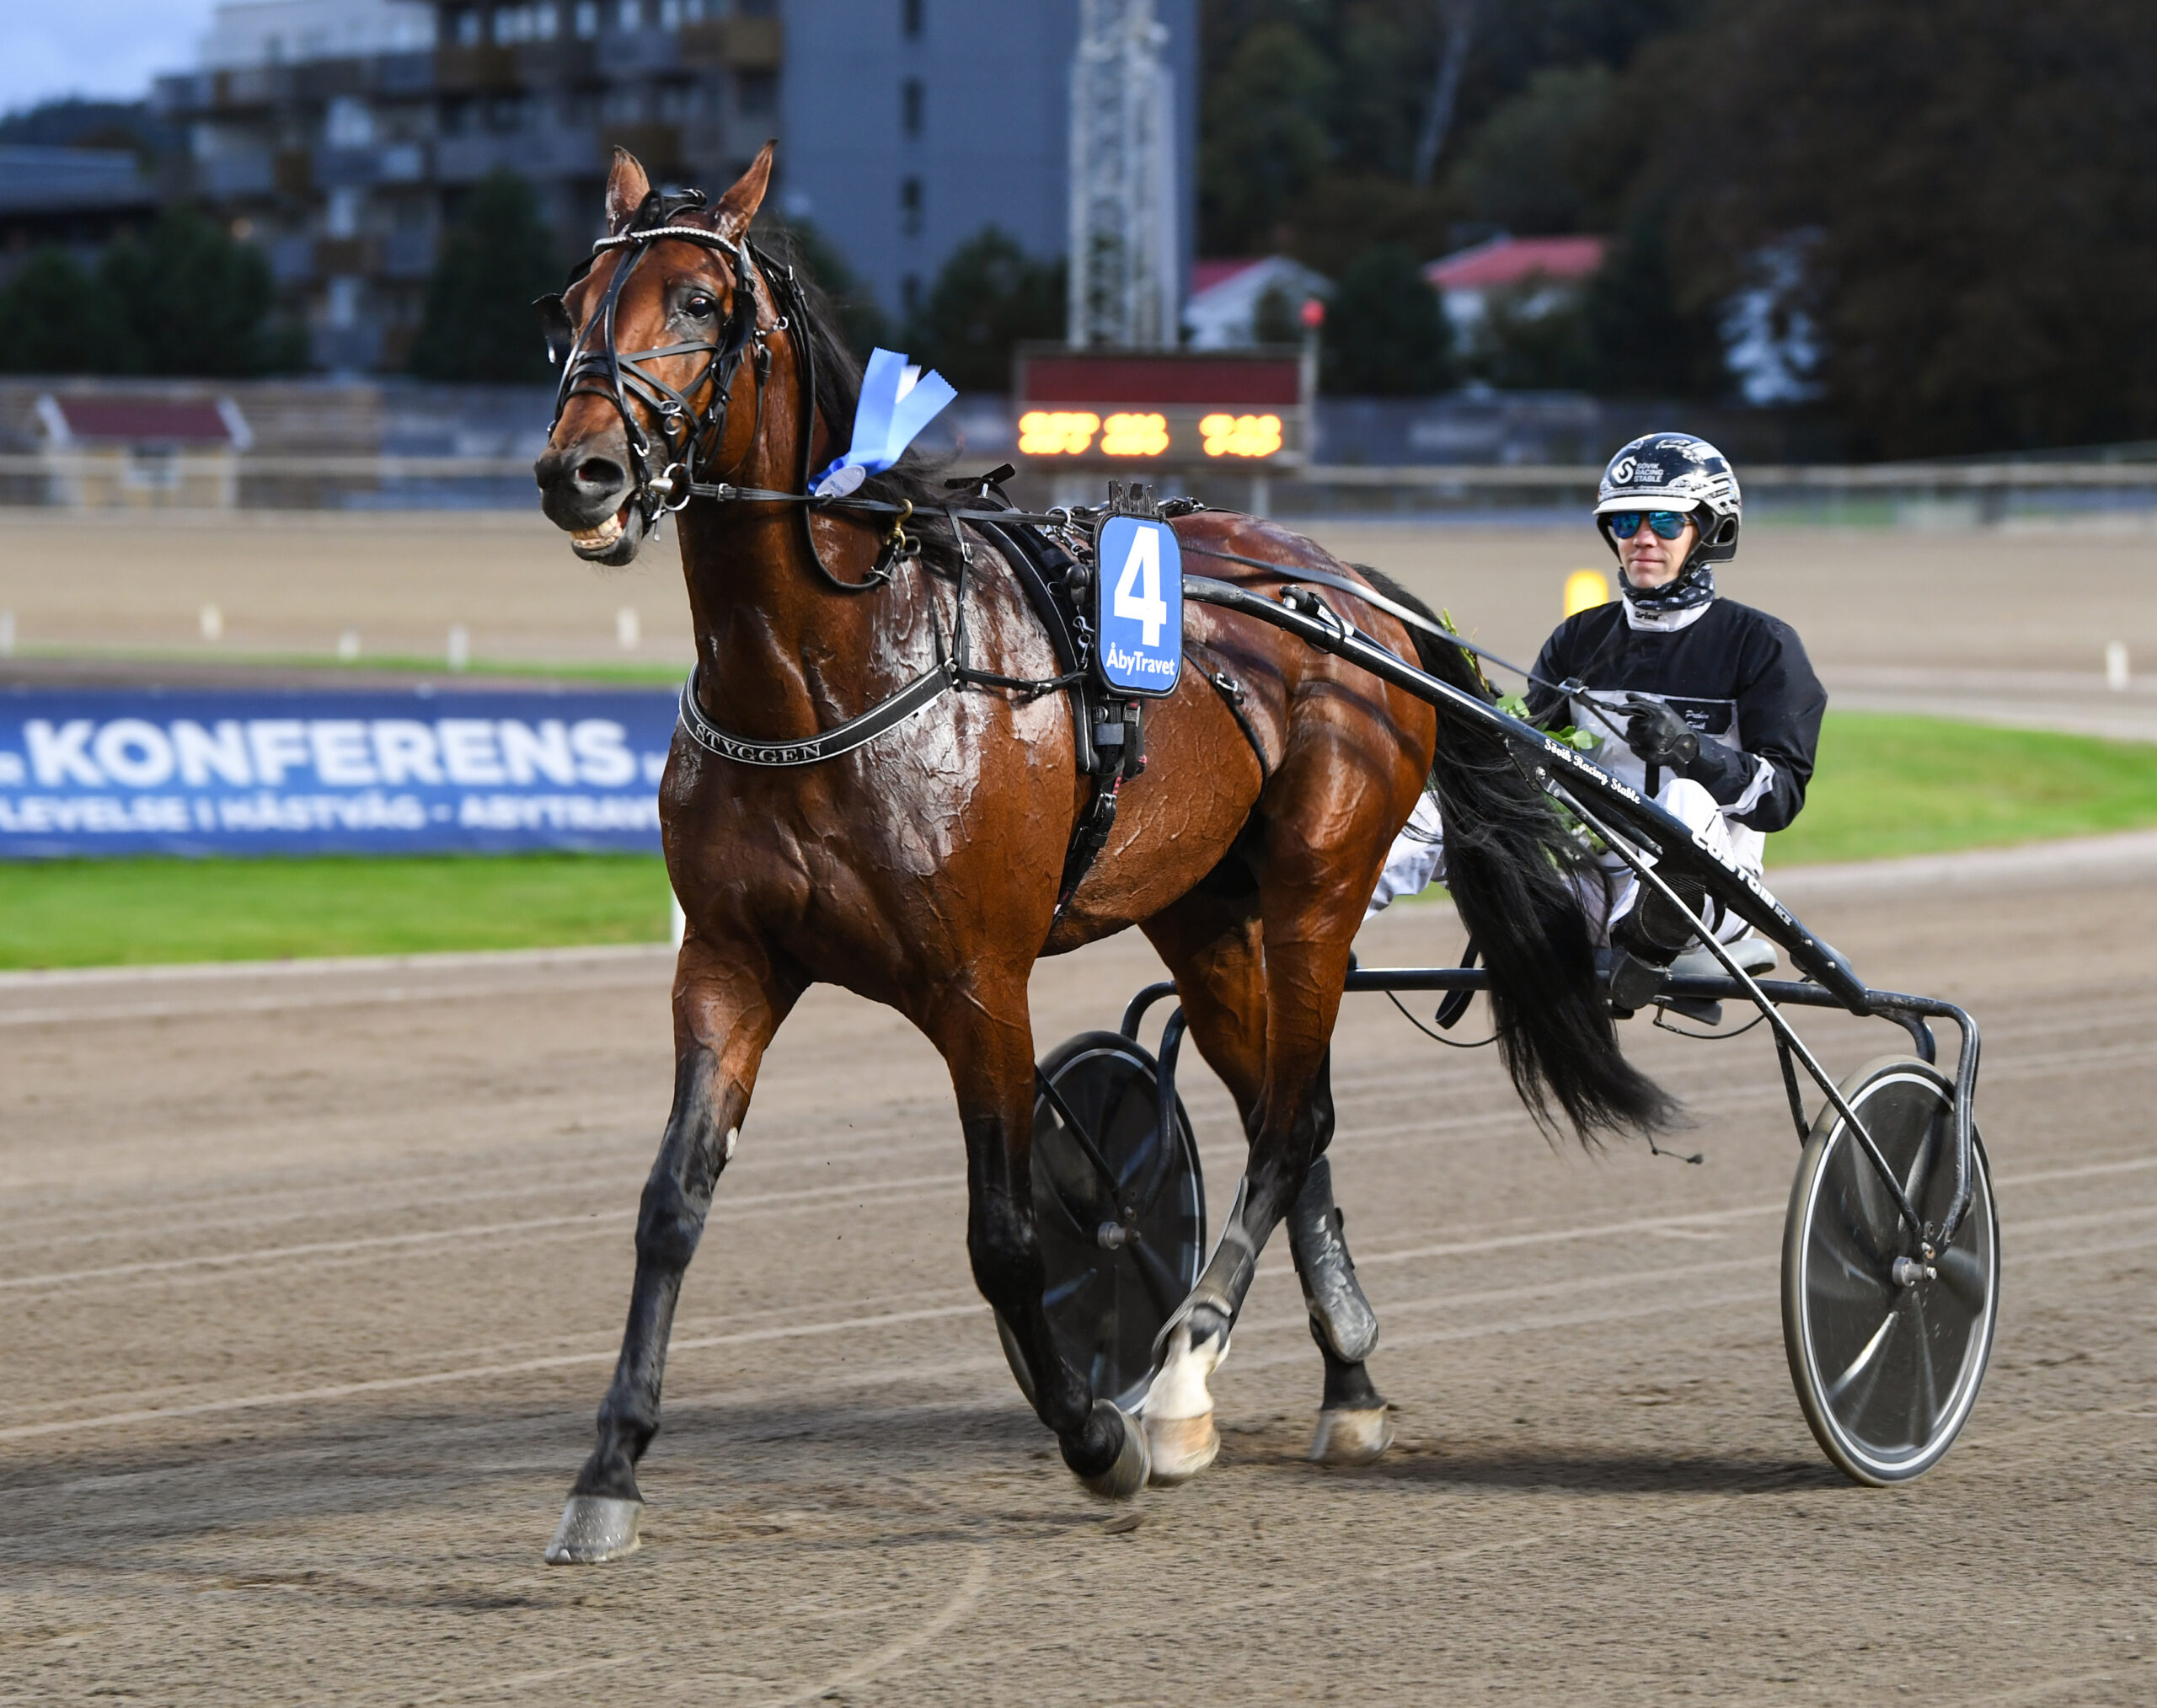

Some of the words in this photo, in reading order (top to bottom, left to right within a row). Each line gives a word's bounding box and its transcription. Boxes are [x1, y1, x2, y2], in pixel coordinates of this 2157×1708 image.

[1113, 526, 1167, 647] 4
[1105, 641, 1175, 676] ÅbyTravet
[24, 717, 638, 788] KONFERENS
[695, 723, 822, 763] STYGGEN
[1572, 755, 1608, 786] Racing
[1610, 777, 1641, 805] Stable
